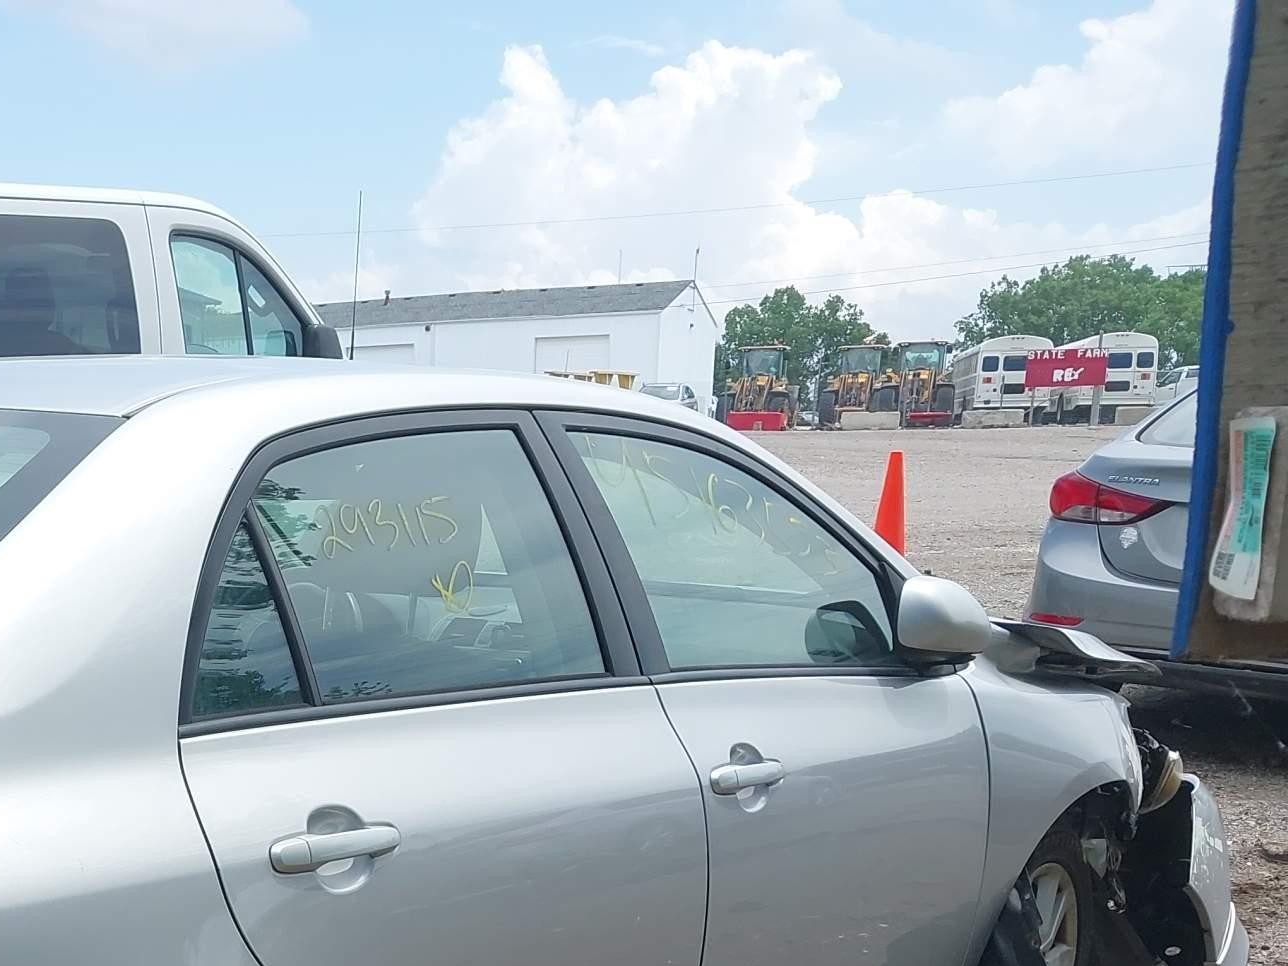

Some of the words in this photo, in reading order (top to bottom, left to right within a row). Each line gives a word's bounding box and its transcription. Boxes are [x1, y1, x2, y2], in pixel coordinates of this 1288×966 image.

[1027, 350, 1065, 360] STATE
[1077, 348, 1108, 358] FARM
[1108, 475, 1161, 487] ELANTRA
[314, 495, 458, 561] 293115
